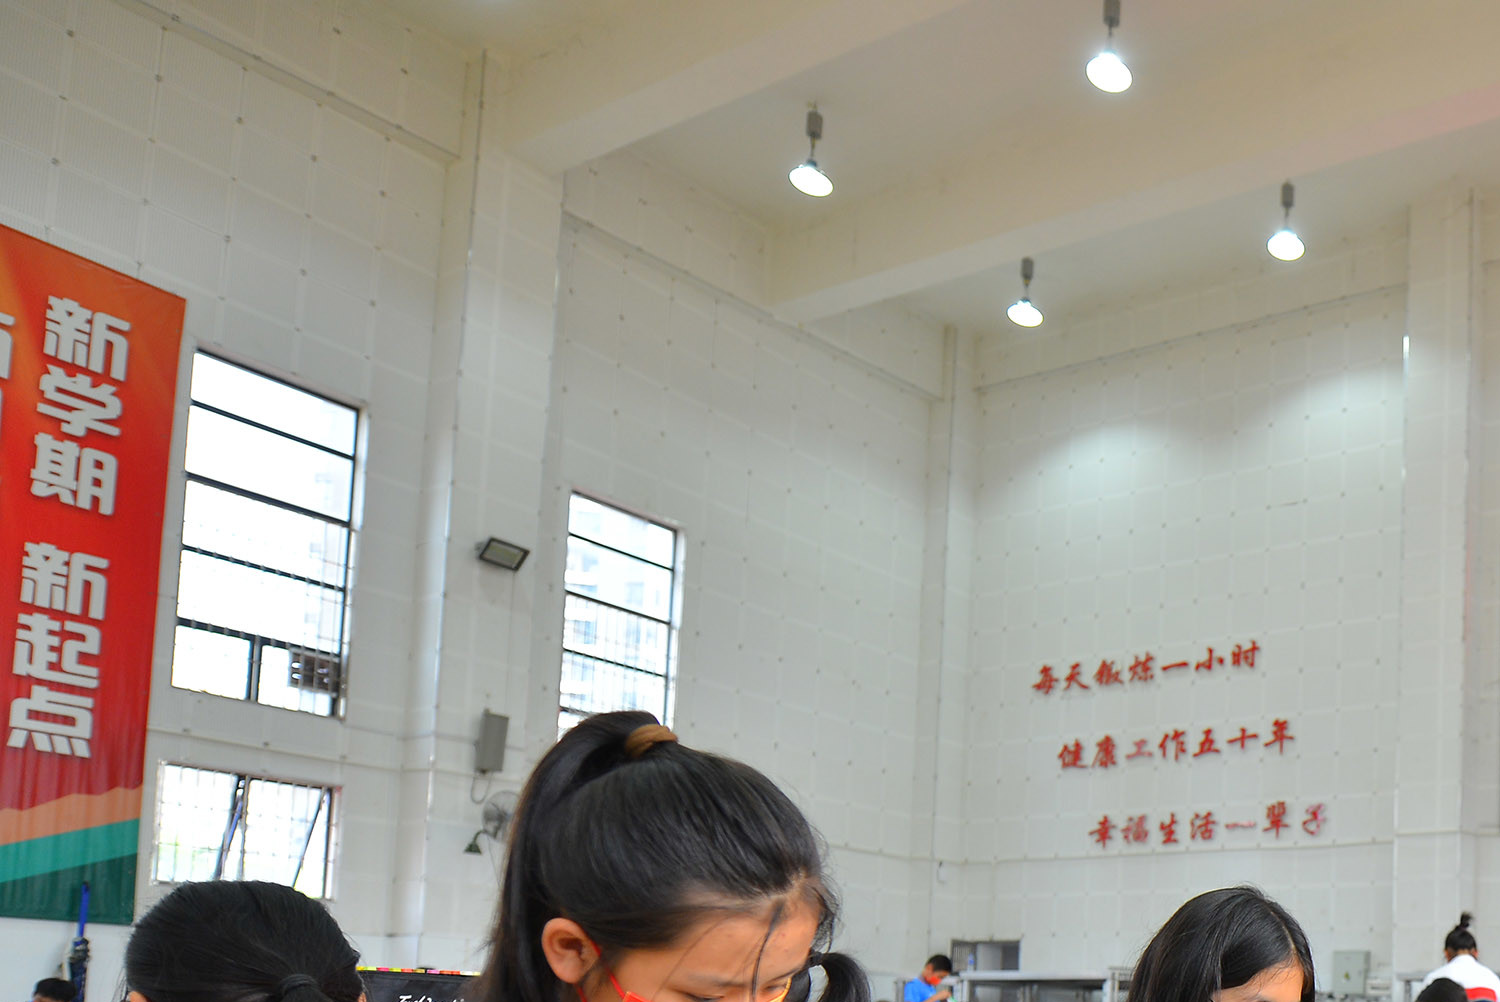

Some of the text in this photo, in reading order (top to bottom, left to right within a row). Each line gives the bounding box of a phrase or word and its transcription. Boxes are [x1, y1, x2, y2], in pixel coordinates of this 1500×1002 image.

[6, 295, 131, 759] 新学期 新起点
[1032, 640, 1260, 694] 每天锻炼一小时
[1057, 718, 1294, 769] 健康工作五十年
[1089, 801, 1325, 848] 幸福生活一辈子
